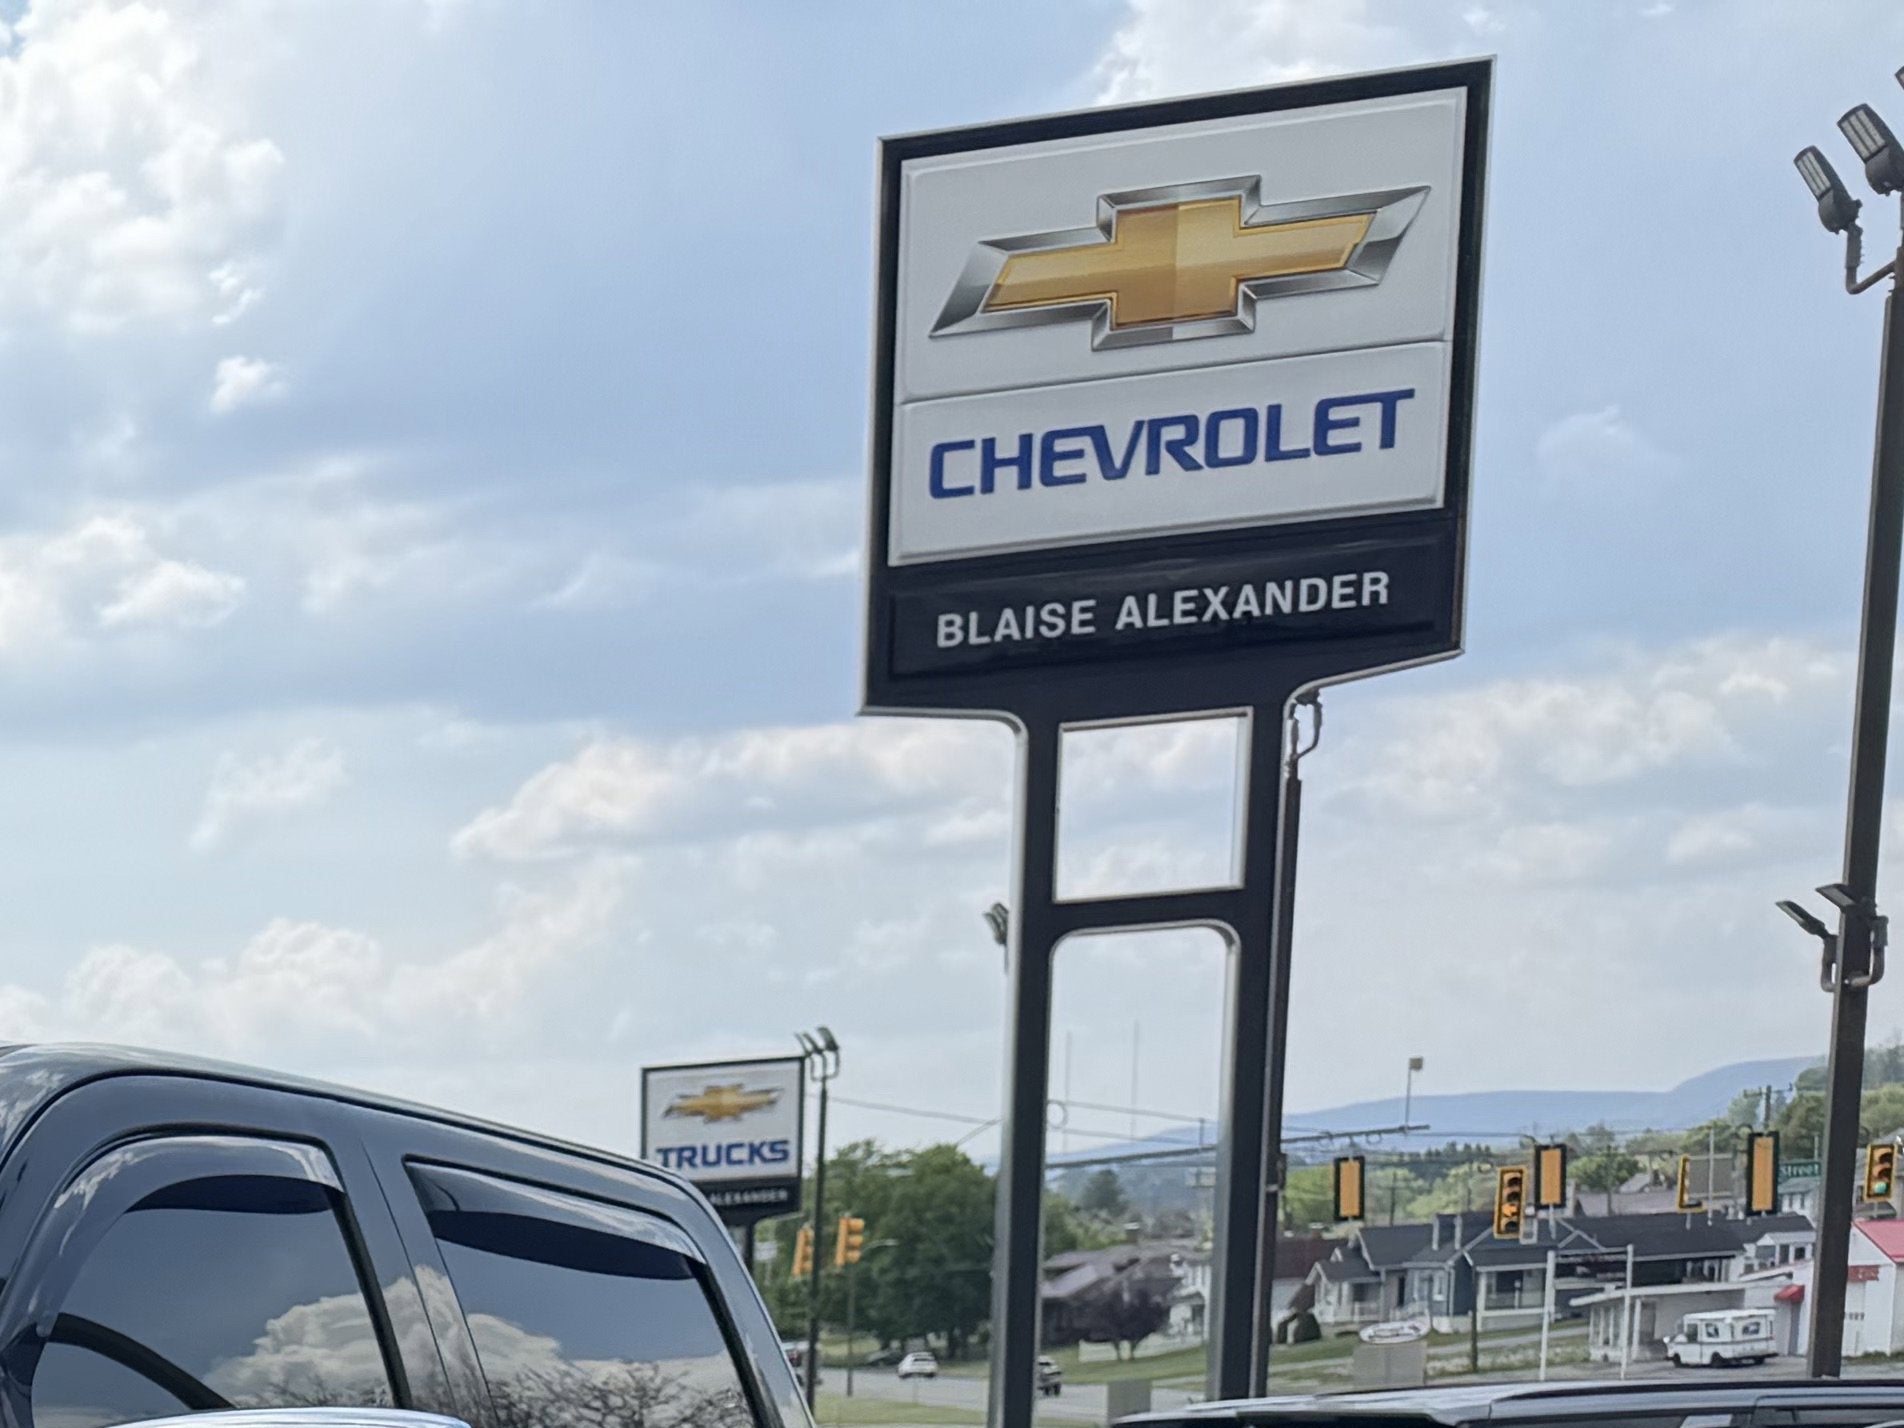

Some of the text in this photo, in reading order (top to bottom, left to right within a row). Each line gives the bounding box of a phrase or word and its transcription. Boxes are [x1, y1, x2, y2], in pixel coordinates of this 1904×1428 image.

[929, 388, 1415, 499] CHEVROLET
[937, 570, 1390, 648] BLAISE ALEXANDER
[656, 1140, 790, 1169] TRUCKS
